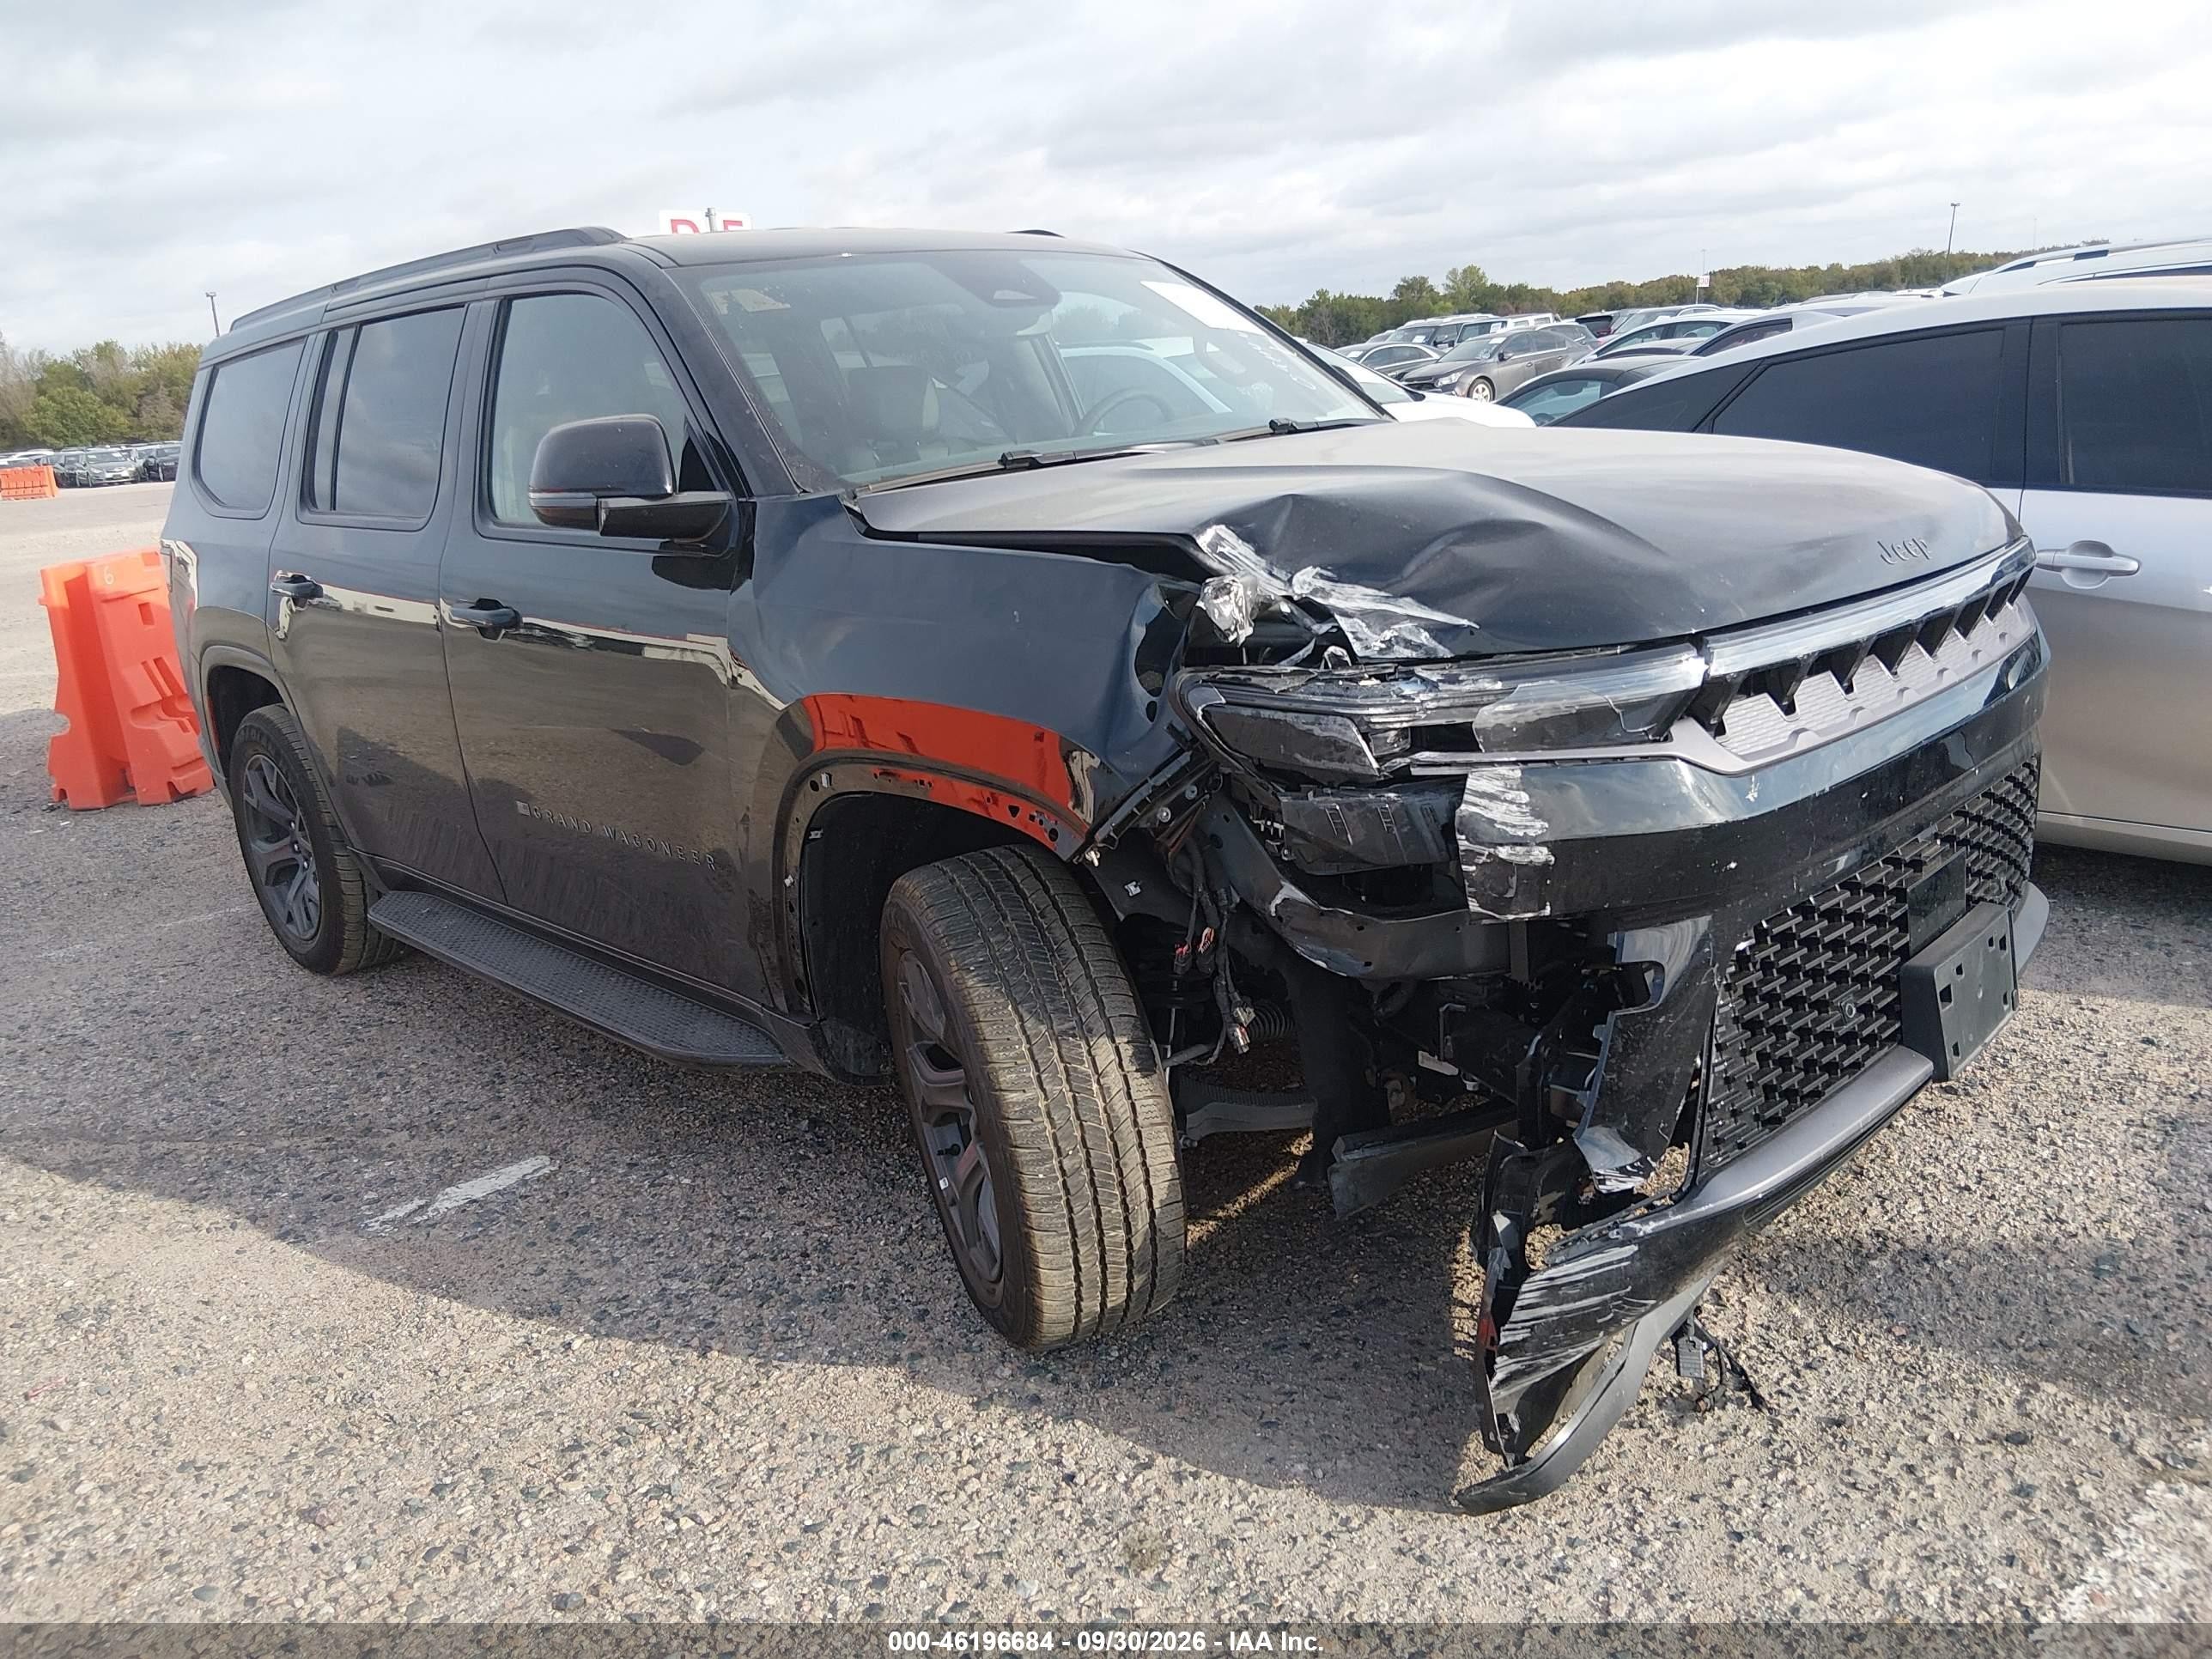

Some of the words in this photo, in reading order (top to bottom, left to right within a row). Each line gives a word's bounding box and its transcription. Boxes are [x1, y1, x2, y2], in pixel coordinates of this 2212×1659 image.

[1877, 538, 1929, 565] Jeep
[533, 805, 592, 834] GRAND
[604, 825, 716, 872] WAGONEER
